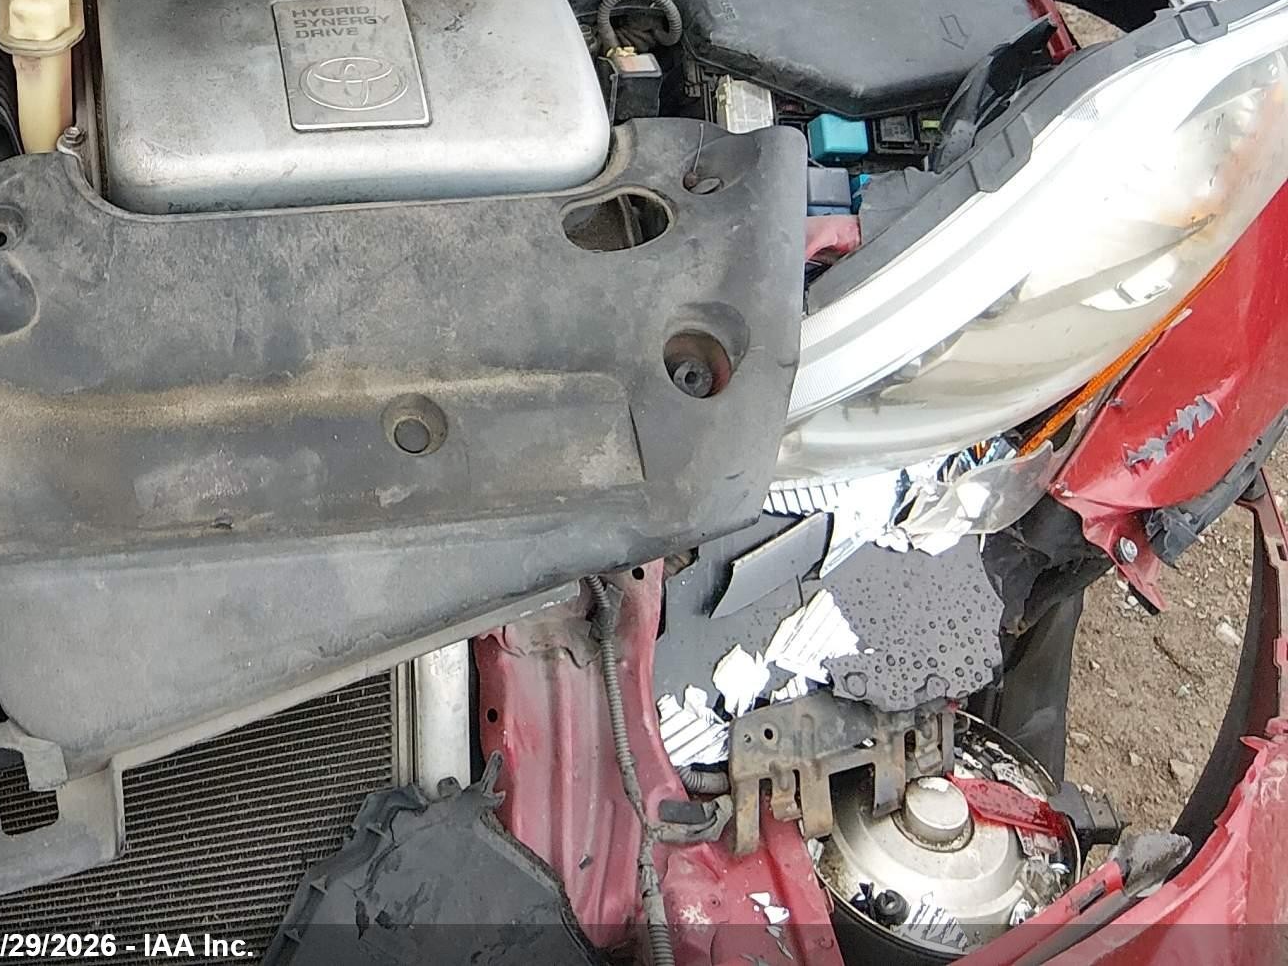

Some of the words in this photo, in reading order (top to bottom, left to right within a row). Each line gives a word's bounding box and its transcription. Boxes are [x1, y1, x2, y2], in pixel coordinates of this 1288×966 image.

[292, 6, 370, 18] HYBRID
[294, 15, 390, 28] SYNERGY
[295, 27, 359, 39] DRIVE
